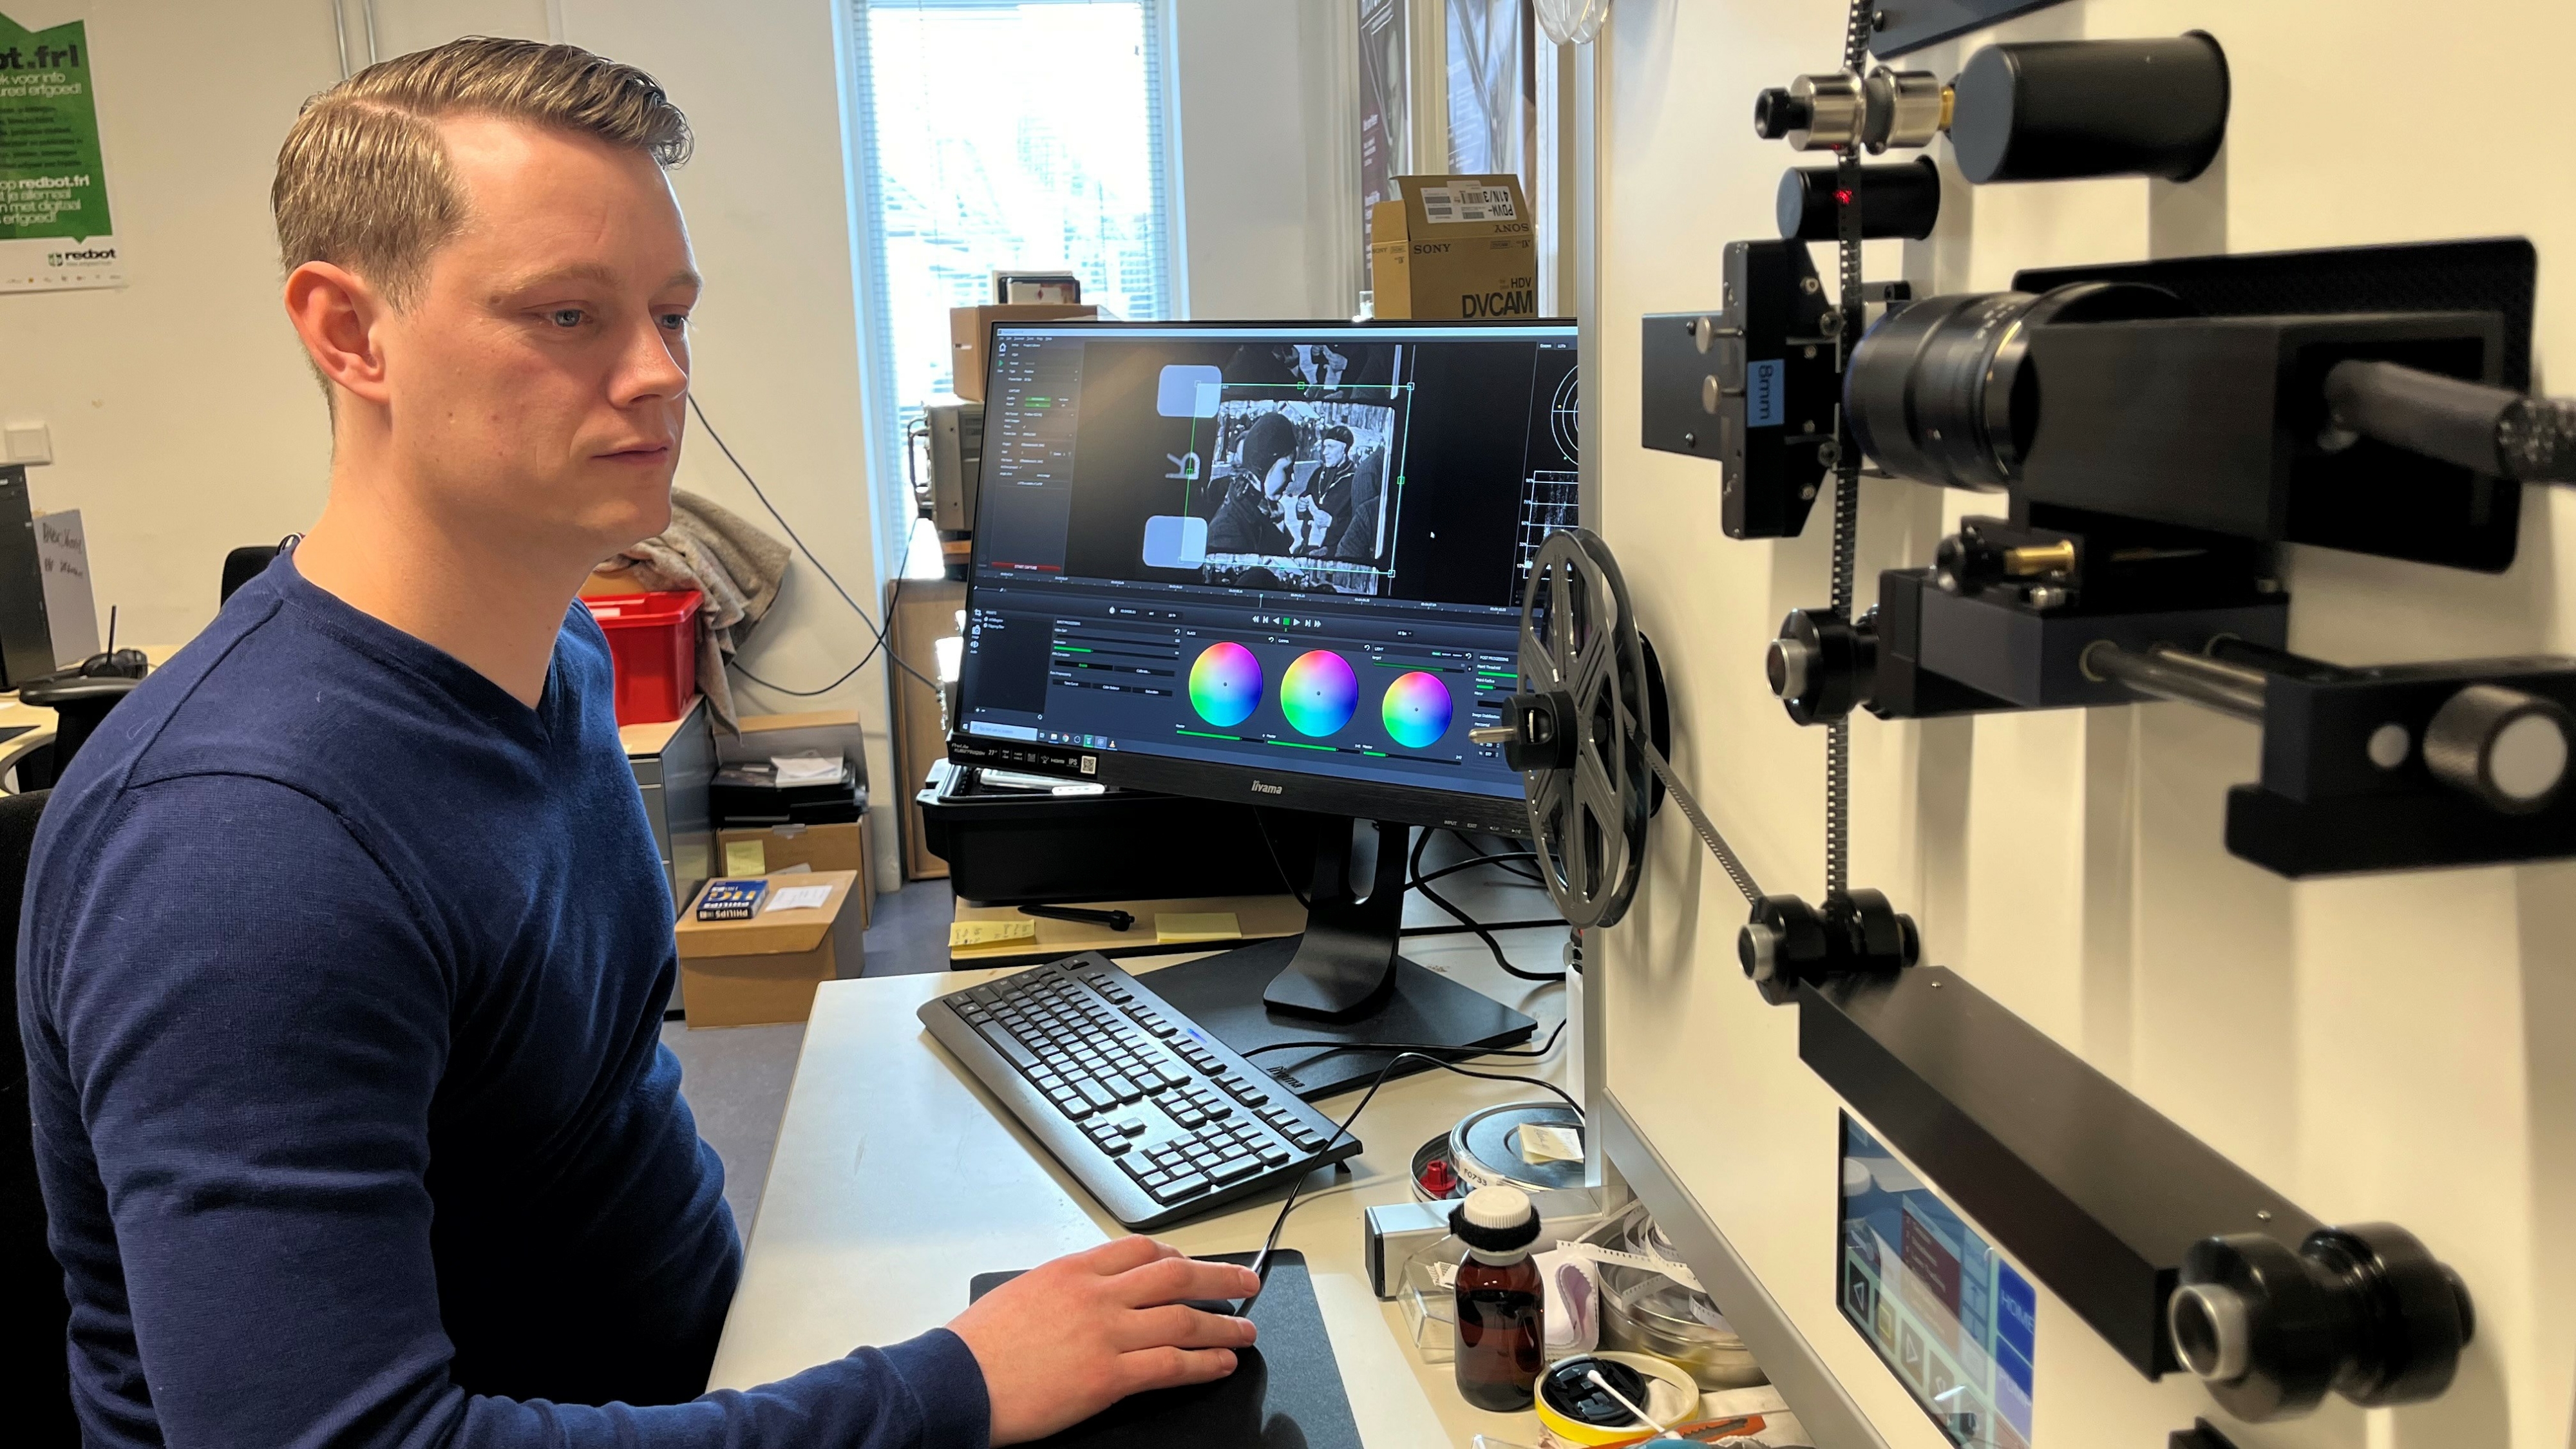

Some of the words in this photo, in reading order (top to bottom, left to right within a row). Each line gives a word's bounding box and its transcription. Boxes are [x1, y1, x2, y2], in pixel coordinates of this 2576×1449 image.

[19, 175, 90, 189] redbot.frl
[1495, 223, 1530, 233] SONY
[65, 248, 116, 260] redbot
[1414, 243, 1451, 254] SONY
[1510, 277, 1531, 288] HDV
[1462, 290, 1533, 318] DVCAM
[1758, 365, 1774, 420] 8mm
[1251, 780, 1282, 795] iiyama
[715, 909, 748, 919] PHILIPS
